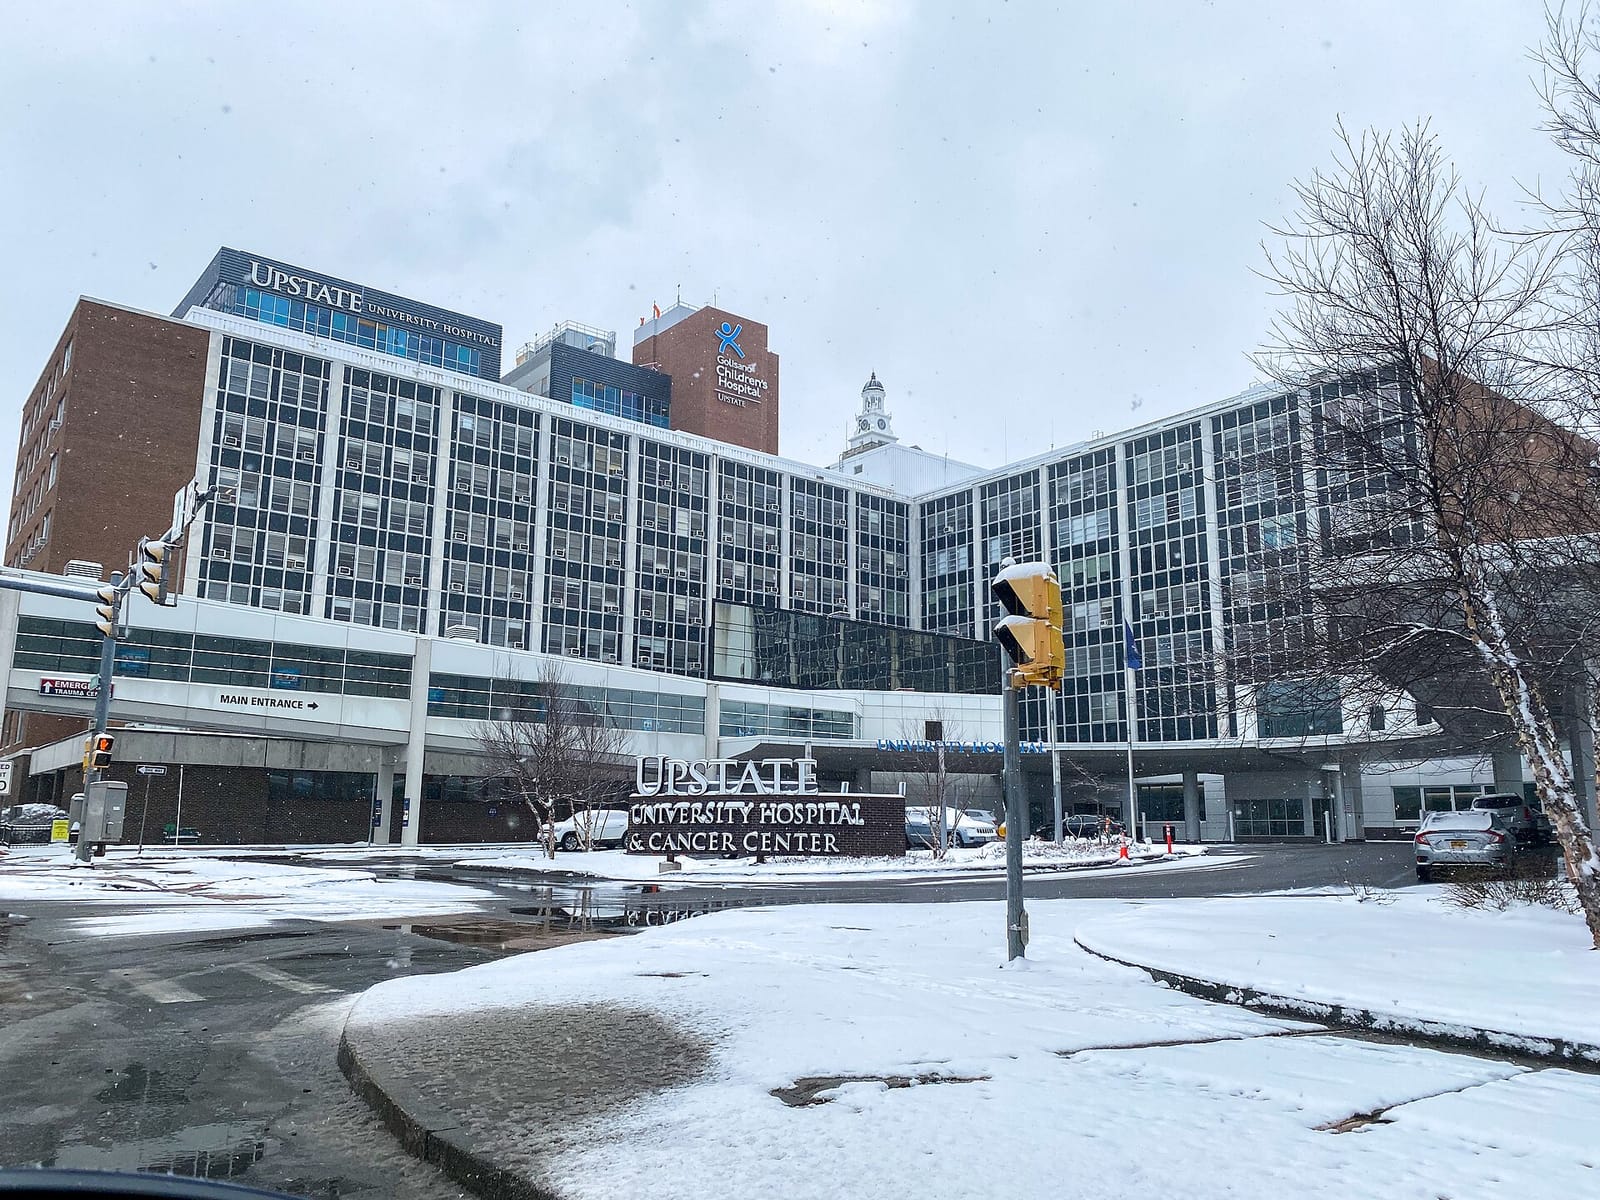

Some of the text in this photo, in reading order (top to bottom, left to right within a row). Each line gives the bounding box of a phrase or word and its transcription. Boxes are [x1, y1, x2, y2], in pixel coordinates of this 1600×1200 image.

[250, 260, 498, 346] UPSTATE UNIVERSITY HOSPITAL
[716, 365, 768, 389] Children's
[718, 376, 762, 397] Hospital
[718, 393, 746, 407] UPSTATE
[54, 688, 84, 696] TRAUMA
[220, 695, 303, 709] MAIN ENTRANCE
[877, 739, 1047, 753] UNIVERITY HOSTAL
[635, 754, 818, 796] UPSTATE
[631, 803, 865, 826] UNIVERSITY HOSPITAL
[629, 832, 840, 852] & CANCER CENTER
